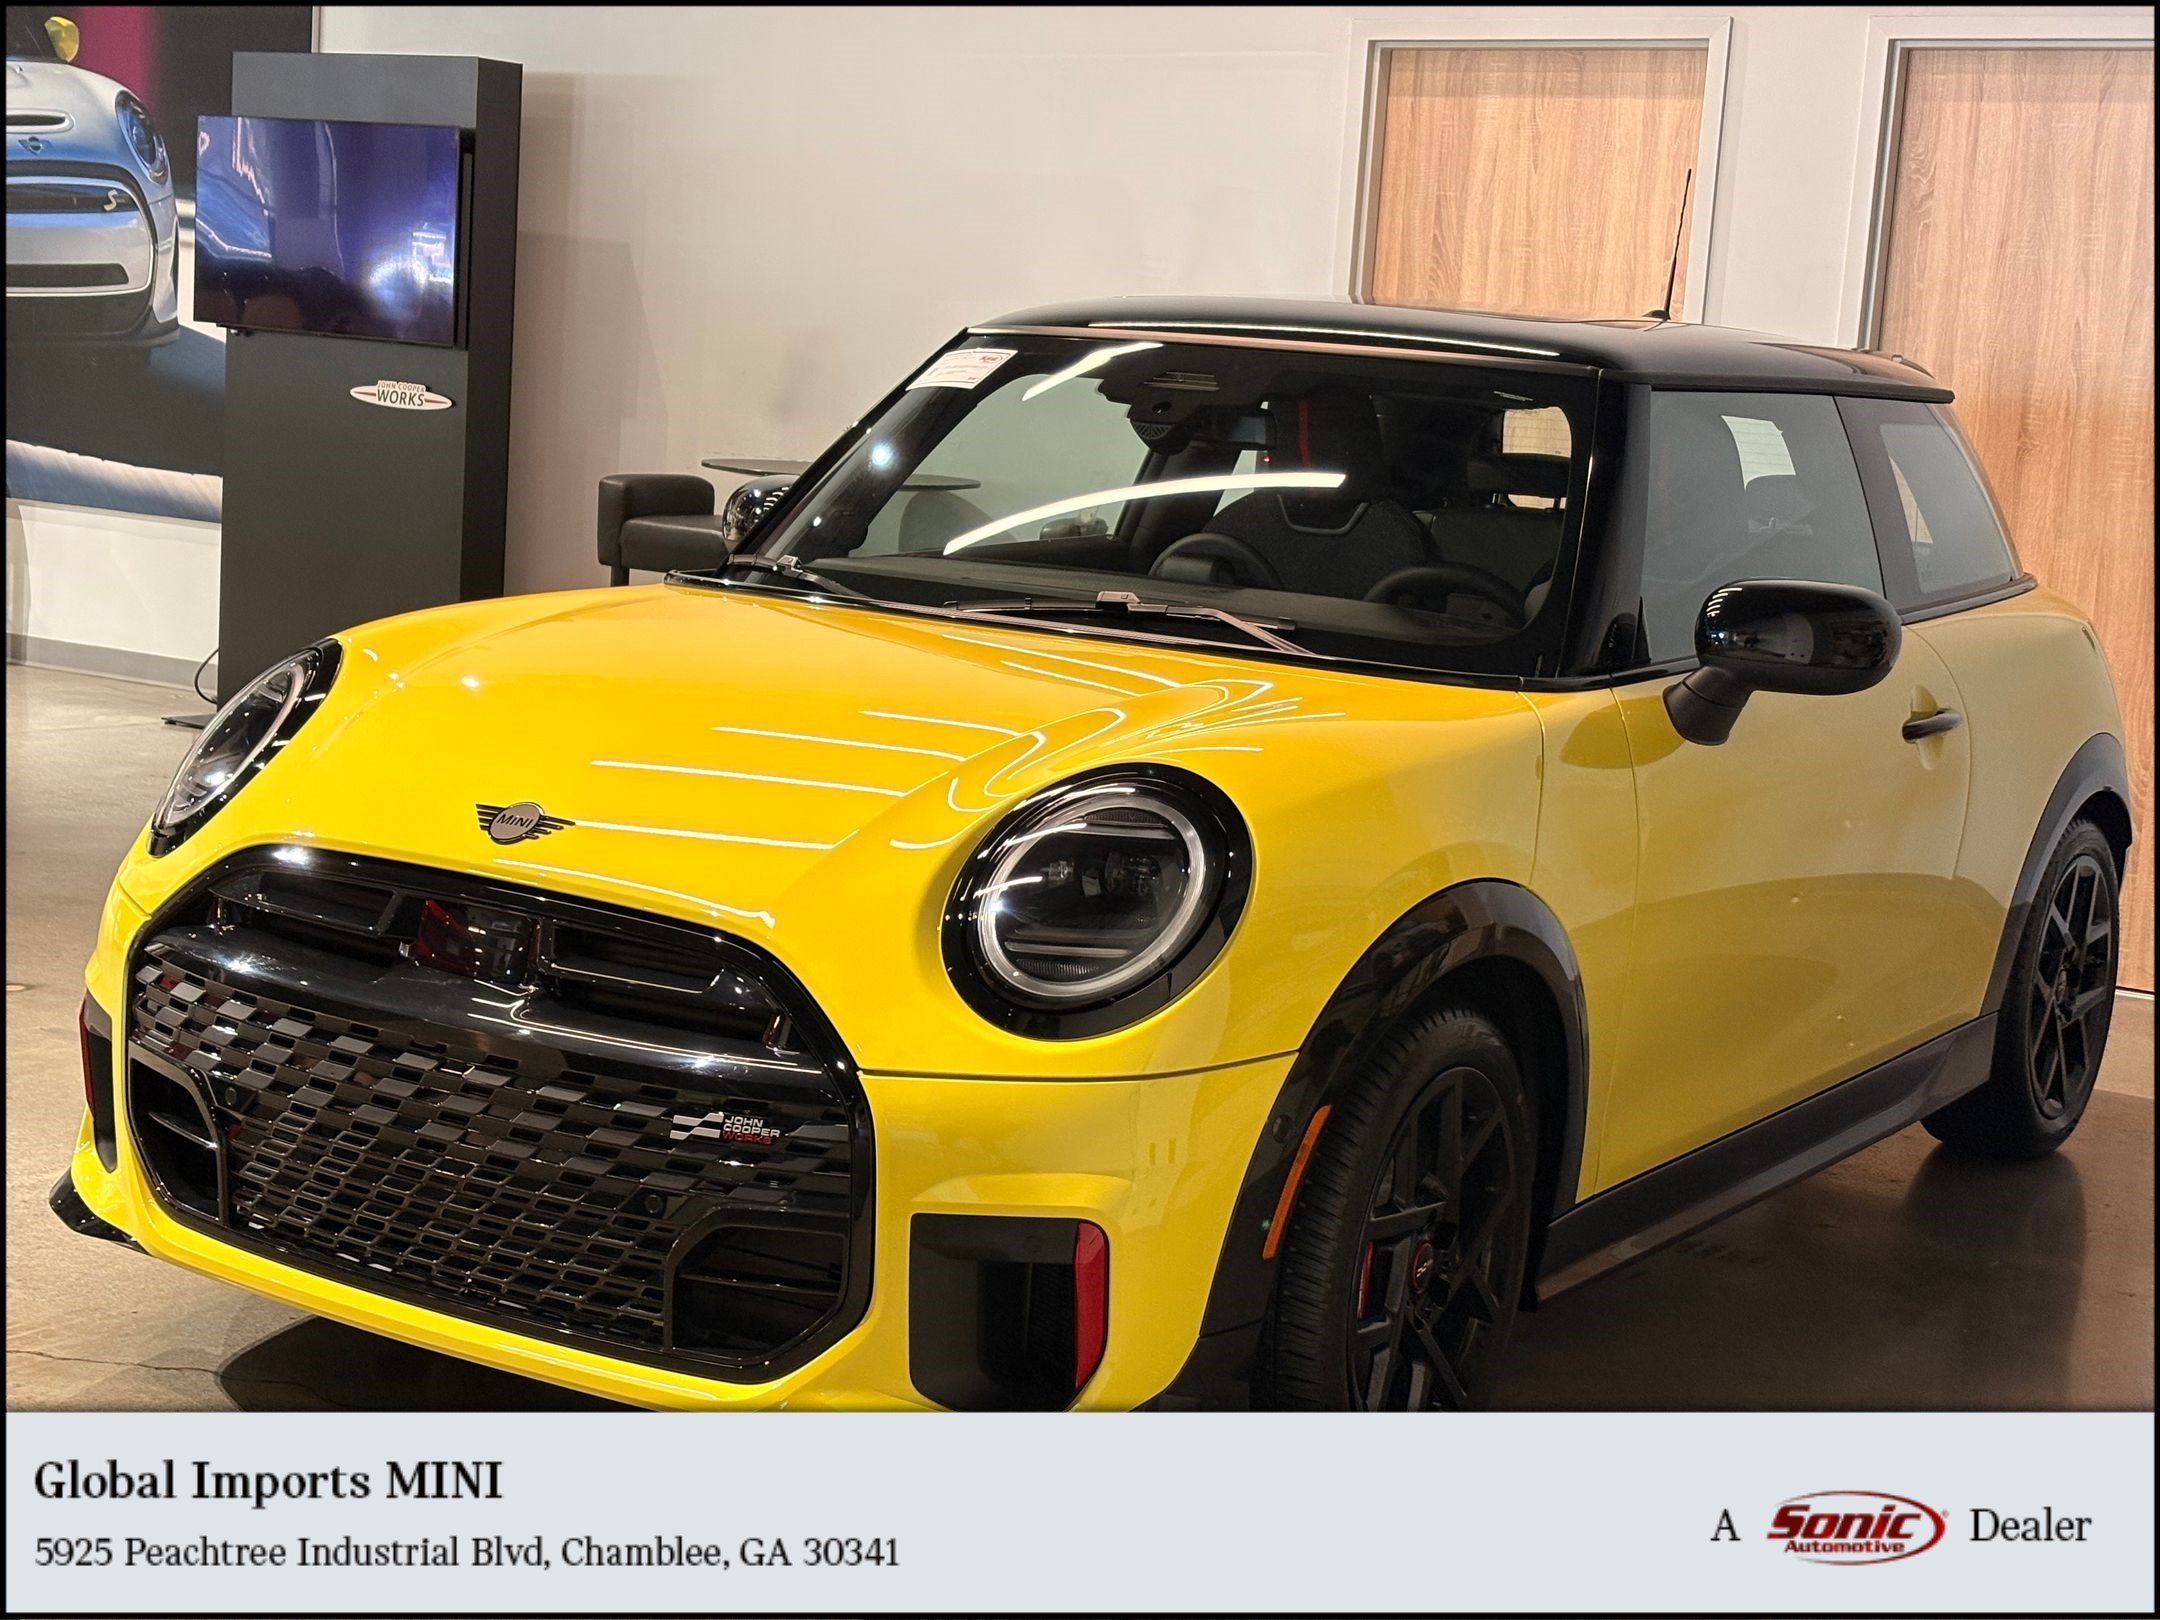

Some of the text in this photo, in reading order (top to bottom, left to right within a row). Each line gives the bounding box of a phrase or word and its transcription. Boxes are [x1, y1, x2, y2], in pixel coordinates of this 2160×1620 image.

[377, 380, 426, 394] JOHN COOPER
[377, 389, 425, 407] WORKS
[497, 813, 534, 828] MINI
[724, 1115, 764, 1128] JOHN
[723, 1123, 781, 1138] COOPER
[722, 1131, 773, 1145] WORKS
